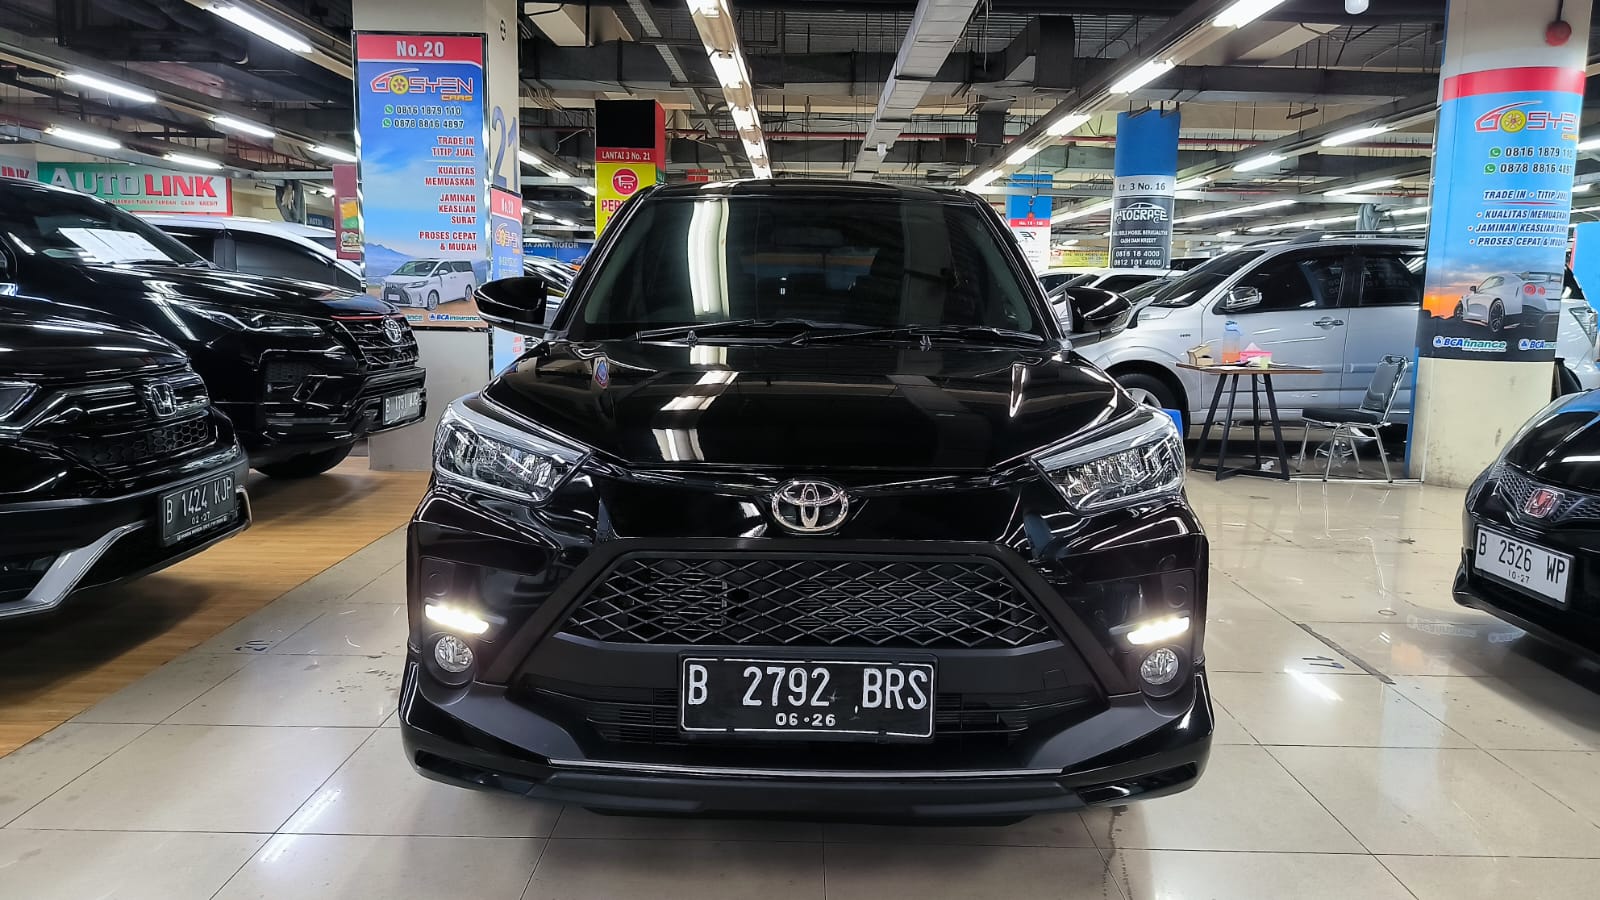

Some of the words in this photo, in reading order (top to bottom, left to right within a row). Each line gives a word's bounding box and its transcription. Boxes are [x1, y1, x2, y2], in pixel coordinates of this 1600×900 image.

[396, 40, 444, 57] No.20
[370, 68, 474, 94] GOSYEN
[396, 105, 418, 115] 0816
[421, 106, 442, 115] 1879
[445, 106, 461, 115] 110
[394, 119, 416, 129] 0878
[418, 120, 440, 129] 8816
[442, 121, 464, 130] 4897
[437, 137, 463, 145] TRADE
[466, 137, 474, 145] IN
[432, 148, 452, 156] TITIP
[602, 151, 624, 160] LANTAI
[626, 152, 630, 160] 3
[1505, 147, 1534, 157] 0816
[1538, 147, 1560, 157] 1879
[438, 167, 475, 175] KUALITAS
[1500, 163, 1529, 173] 0878
[1532, 163, 1556, 173] 8816
[425, 178, 475, 186] MEMUASKAN
[1130, 183, 1135, 191] 3
[440, 194, 476, 202] JAMINAN
[1484, 191, 1513, 199] TRADE
[1537, 191, 1555, 199] TITIP
[439, 205, 476, 213] KEASLIAN
[1485, 210, 1528, 219] KUALITAS
[451, 216, 476, 224] SURAT
[1476, 223, 1519, 232] JAMINAN
[1520, 224, 1555, 233] KEASLIAN
[419, 232, 450, 240] PROSES
[452, 232, 476, 240] CEPAT
[1478, 237, 1513, 246] PROSES
[1516, 238, 1541, 246] CEPAT
[440, 243, 446, 251] &
[448, 243, 477, 251] MUDAH
[167, 500, 173, 524] B
[182, 485, 208, 517] 1424
[214, 477, 232, 504] KJP
[1479, 533, 1487, 556] B
[1498, 540, 1533, 572] 2526
[1546, 555, 1566, 584] WP
[687, 664, 708, 705] B
[742, 666, 830, 707] 2792
[862, 668, 928, 710] BRS
